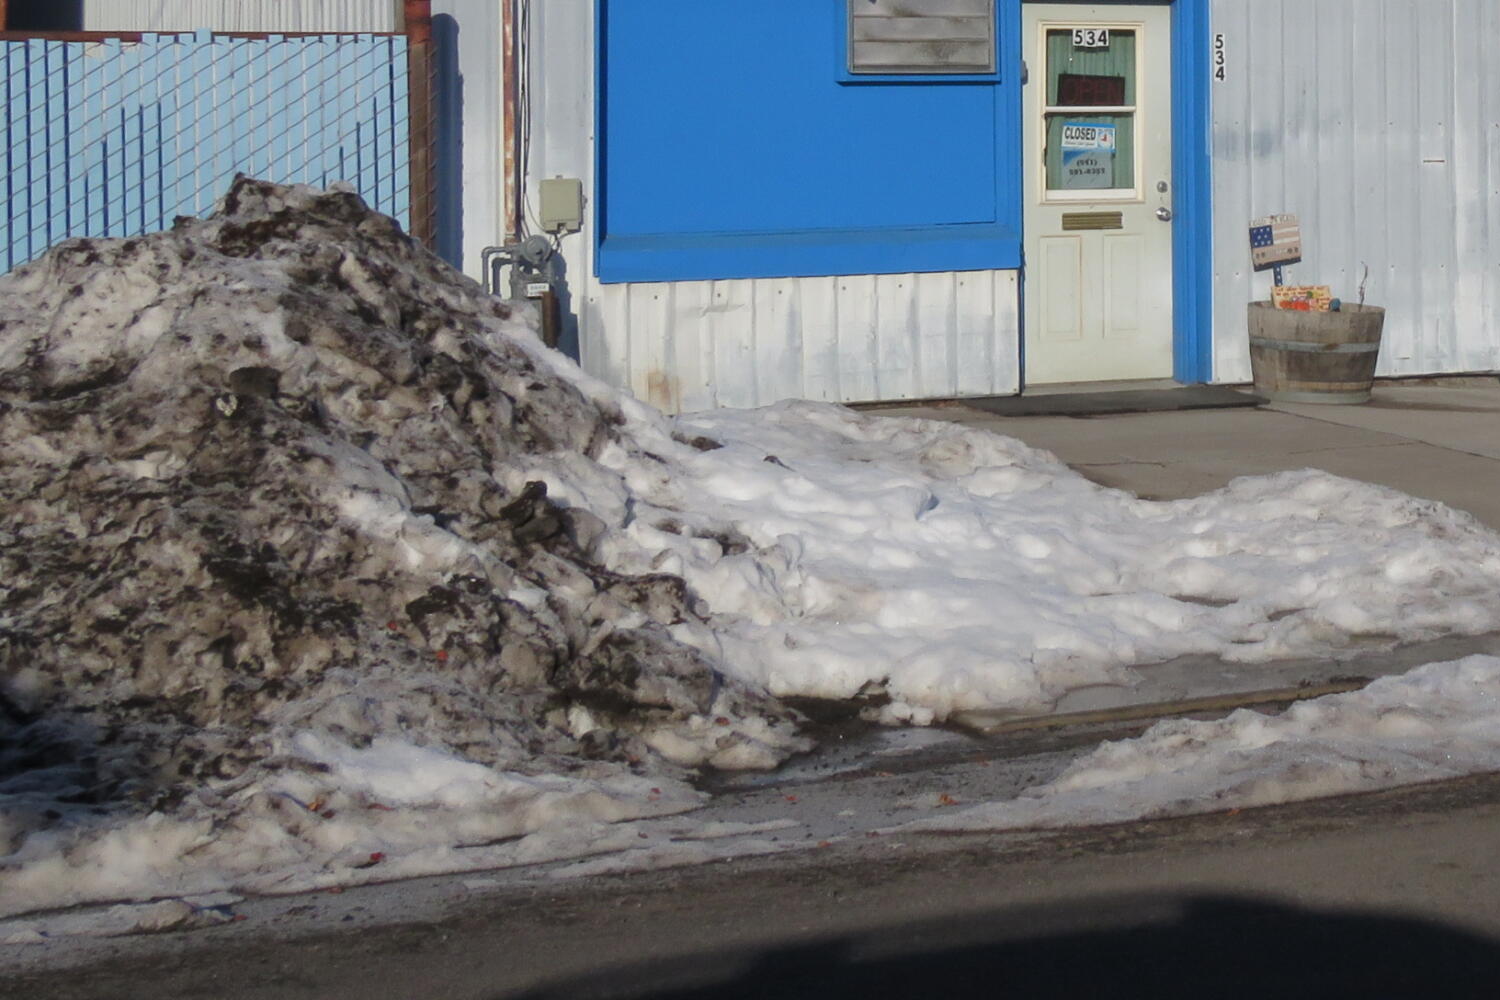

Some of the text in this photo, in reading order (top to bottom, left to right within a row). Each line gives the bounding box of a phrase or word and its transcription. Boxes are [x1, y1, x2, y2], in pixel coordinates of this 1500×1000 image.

[1074, 30, 1108, 45] 534
[1215, 34, 1225, 81] 534
[1064, 126, 1097, 141] CLOSED
